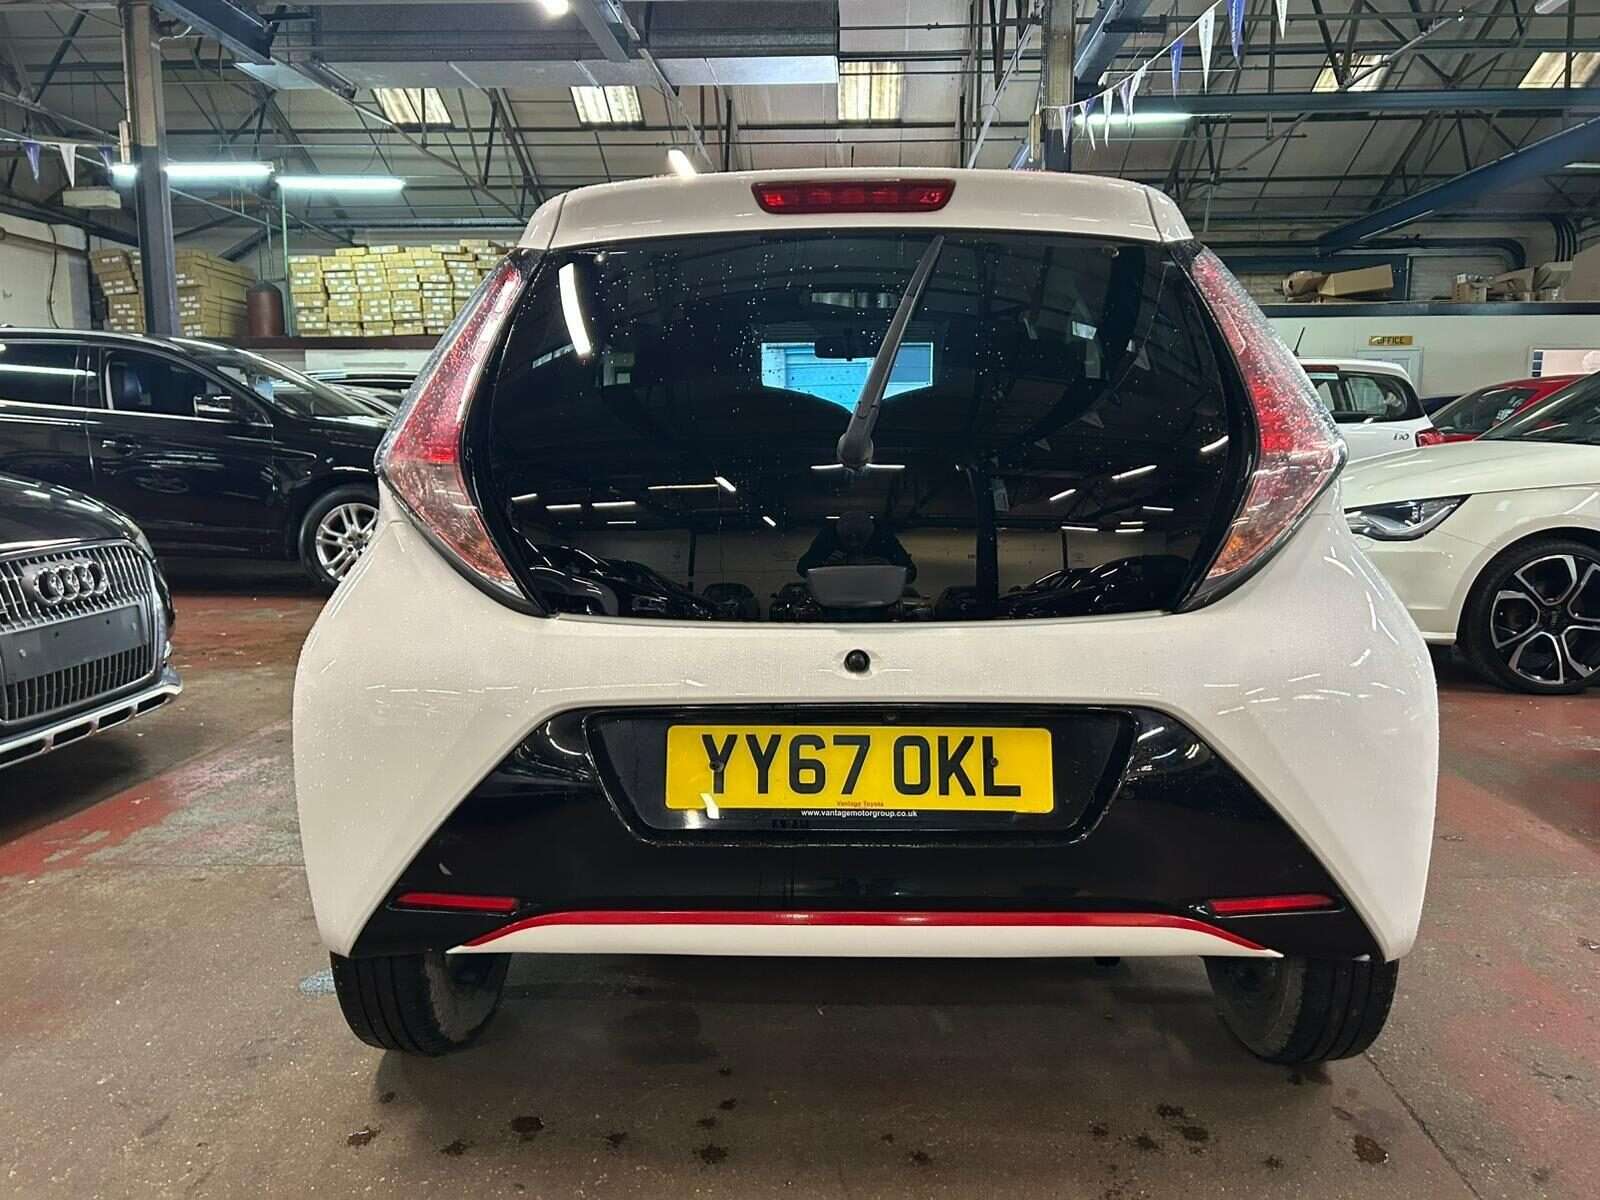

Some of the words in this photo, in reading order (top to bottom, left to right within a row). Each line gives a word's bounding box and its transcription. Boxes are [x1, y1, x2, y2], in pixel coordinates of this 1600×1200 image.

[702, 734, 871, 795] YY67
[893, 735, 1022, 797] OKL
[801, 809, 918, 818] www.vantagemotorgroup.co.uk
